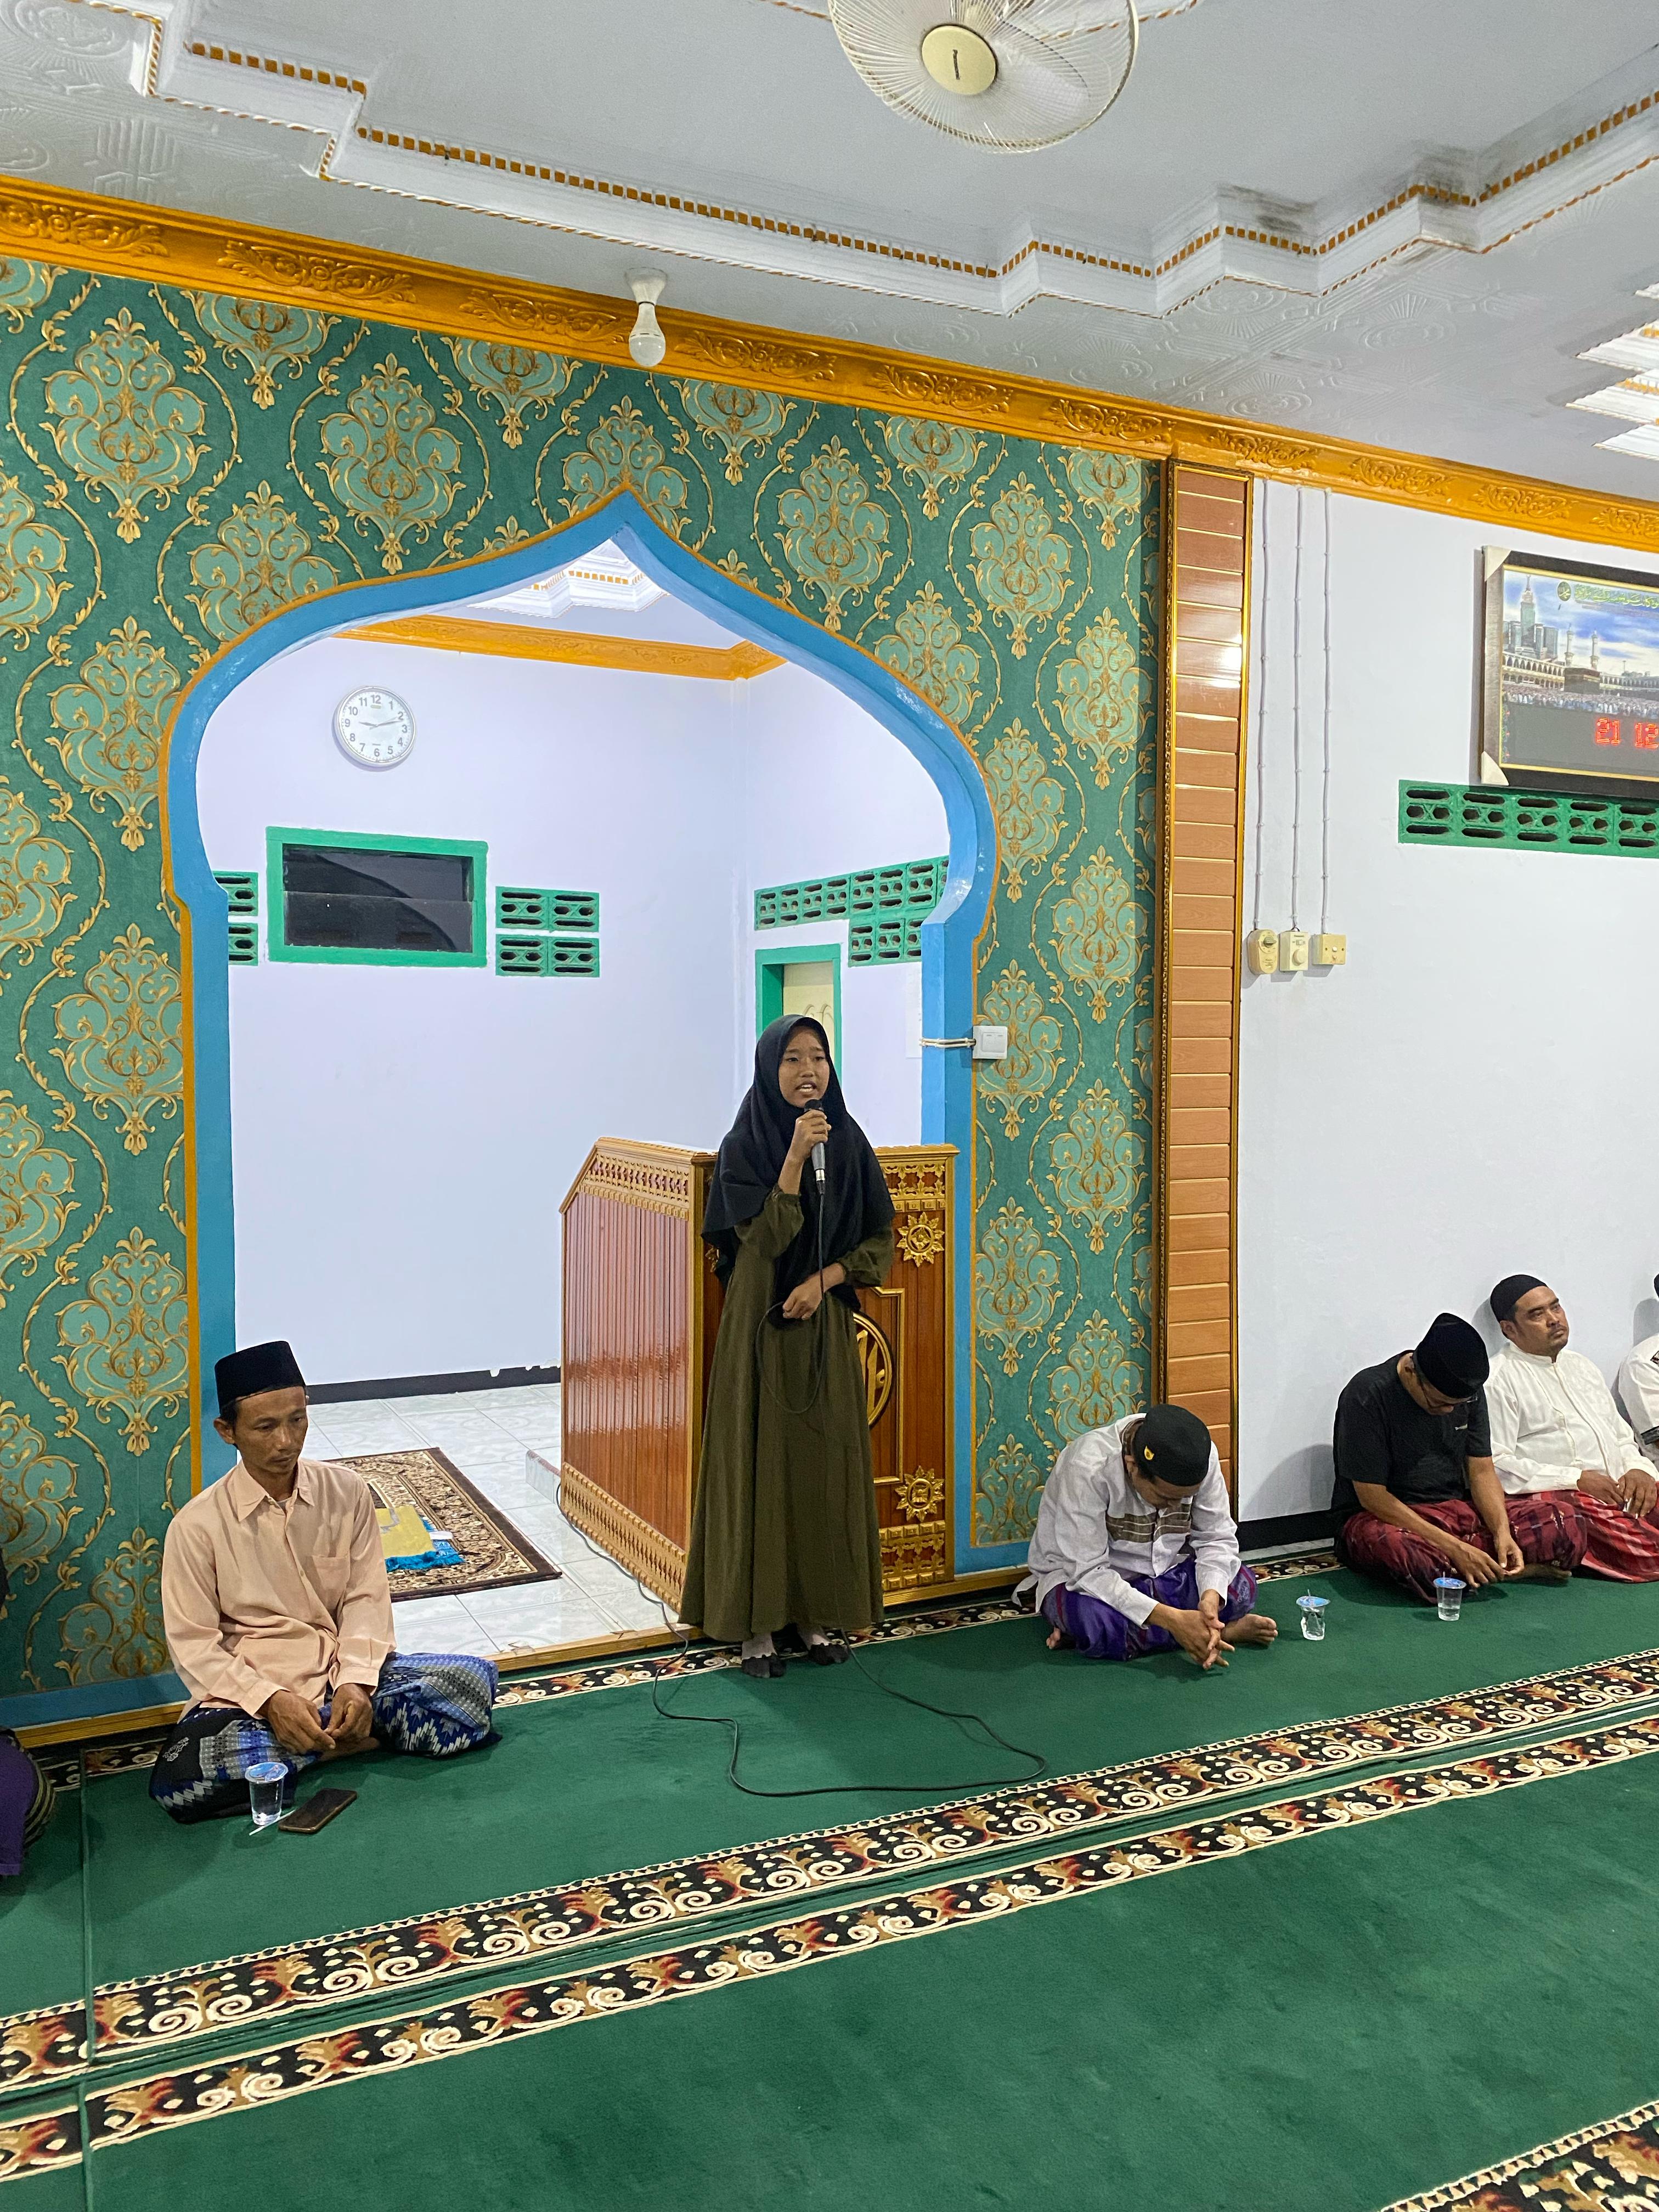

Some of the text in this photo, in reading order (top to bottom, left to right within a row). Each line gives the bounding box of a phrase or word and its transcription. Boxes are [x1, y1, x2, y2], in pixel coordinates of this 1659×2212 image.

[359, 697, 368, 707] 11
[371, 695, 381, 704] 12
[389, 701, 393, 710] 1
[348, 707, 358, 715] 10
[398, 712, 404, 720] 2
[345, 719, 351, 727] 9
[402, 724, 408, 733] 3
[1596, 718, 1658, 748] 21 12
[349, 733, 356, 742] 8
[397, 737, 403, 747] 4
[359, 743, 365, 752] 7
[387, 746, 393, 755] 5
[374, 748, 380, 757] 6
